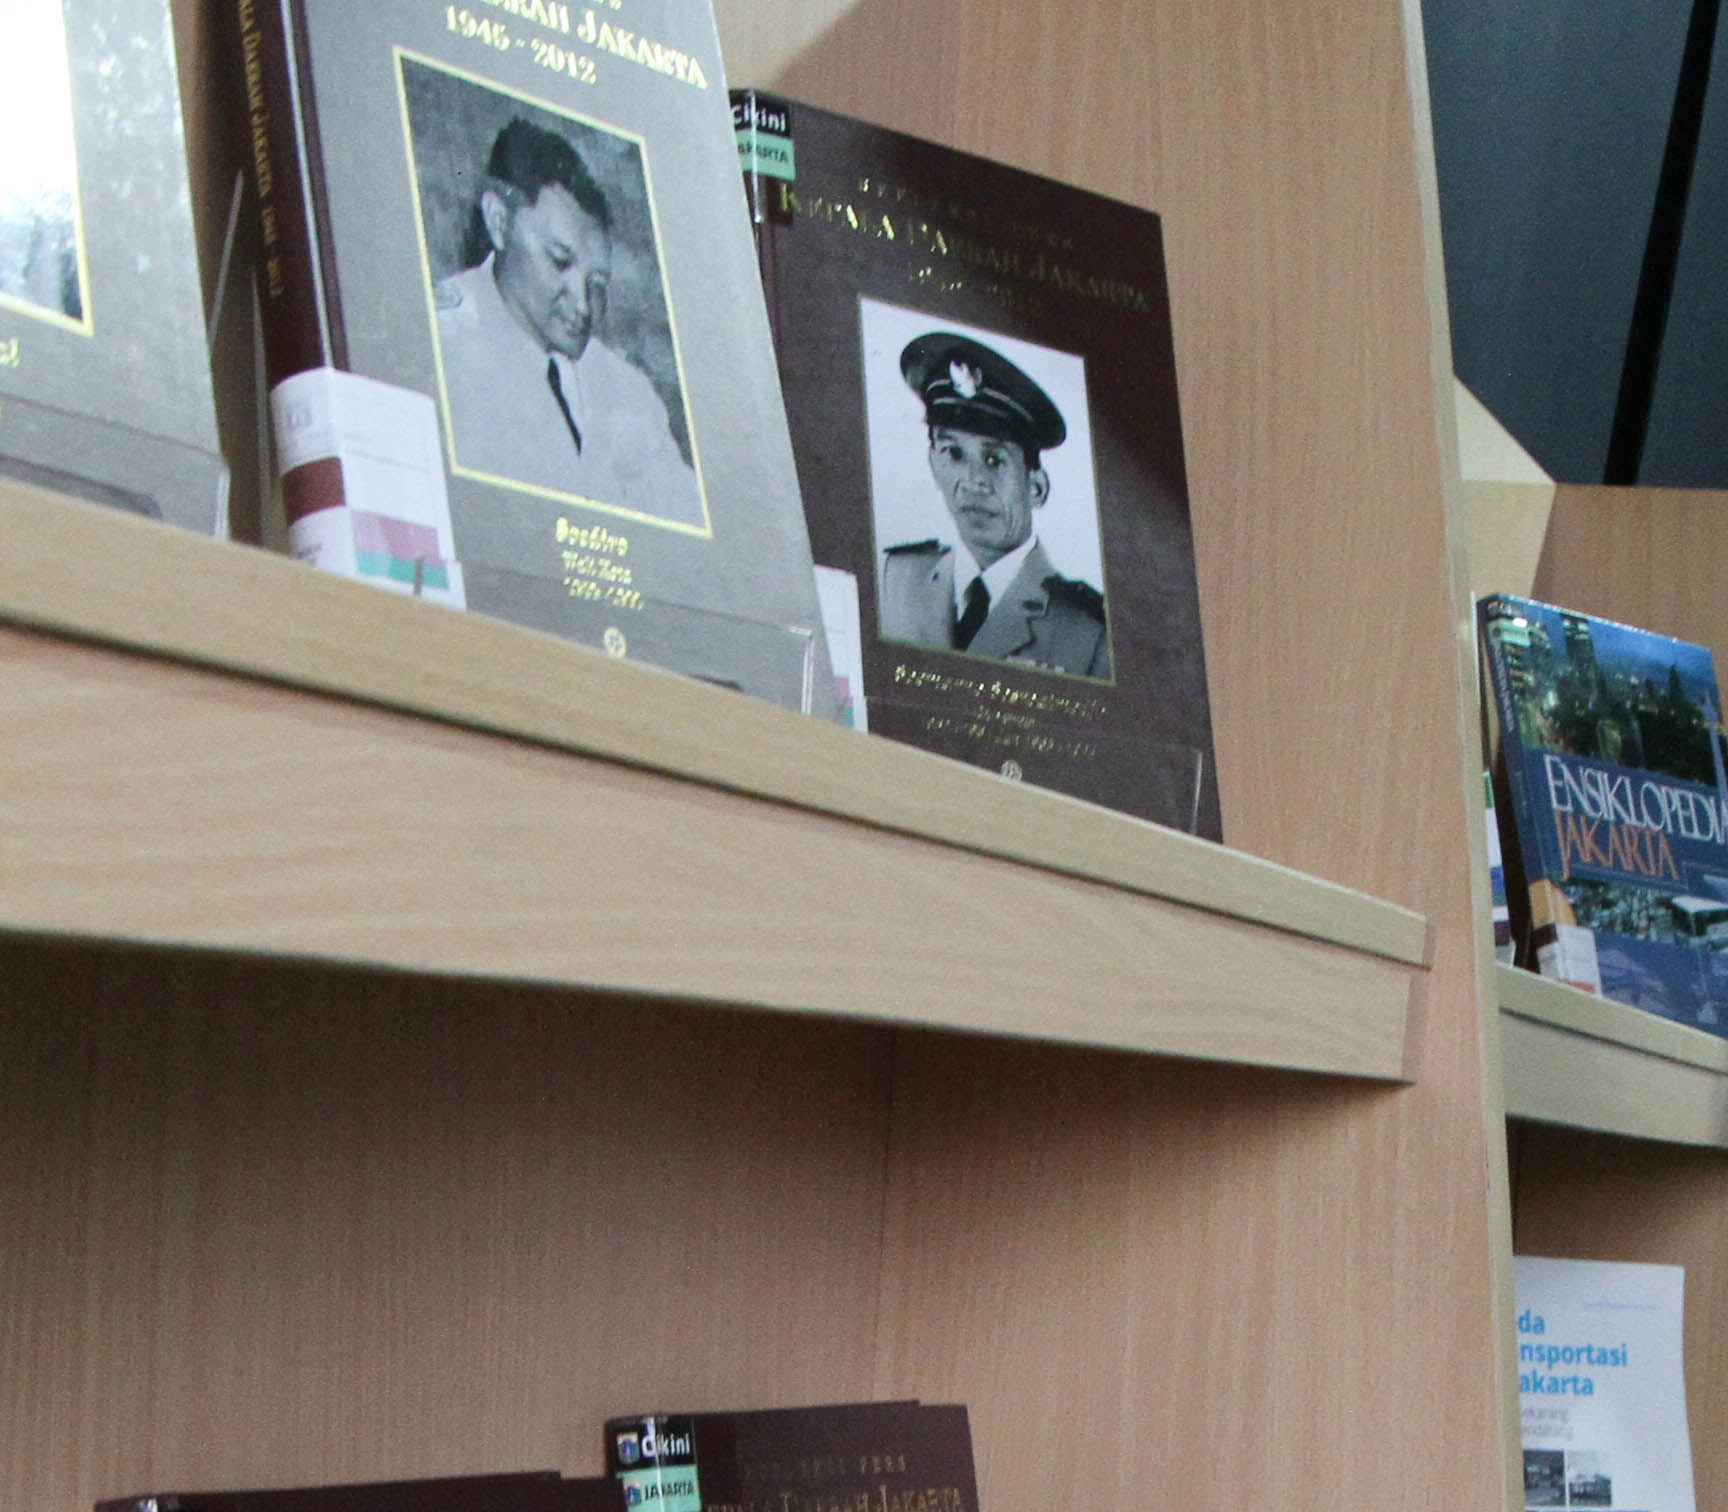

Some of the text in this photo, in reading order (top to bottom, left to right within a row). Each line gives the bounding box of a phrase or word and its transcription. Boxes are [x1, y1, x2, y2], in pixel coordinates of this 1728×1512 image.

[446, 5, 511, 52] 1945
[529, 37, 598, 85] 2012
[576, 9, 709, 91] JAKARTA
[1554, 811, 1680, 881] JAKARTA
[1517, 1308, 1546, 1335] da
[1519, 1342, 1629, 1371] nsportasi
[1519, 1368, 1595, 1397] akarta
